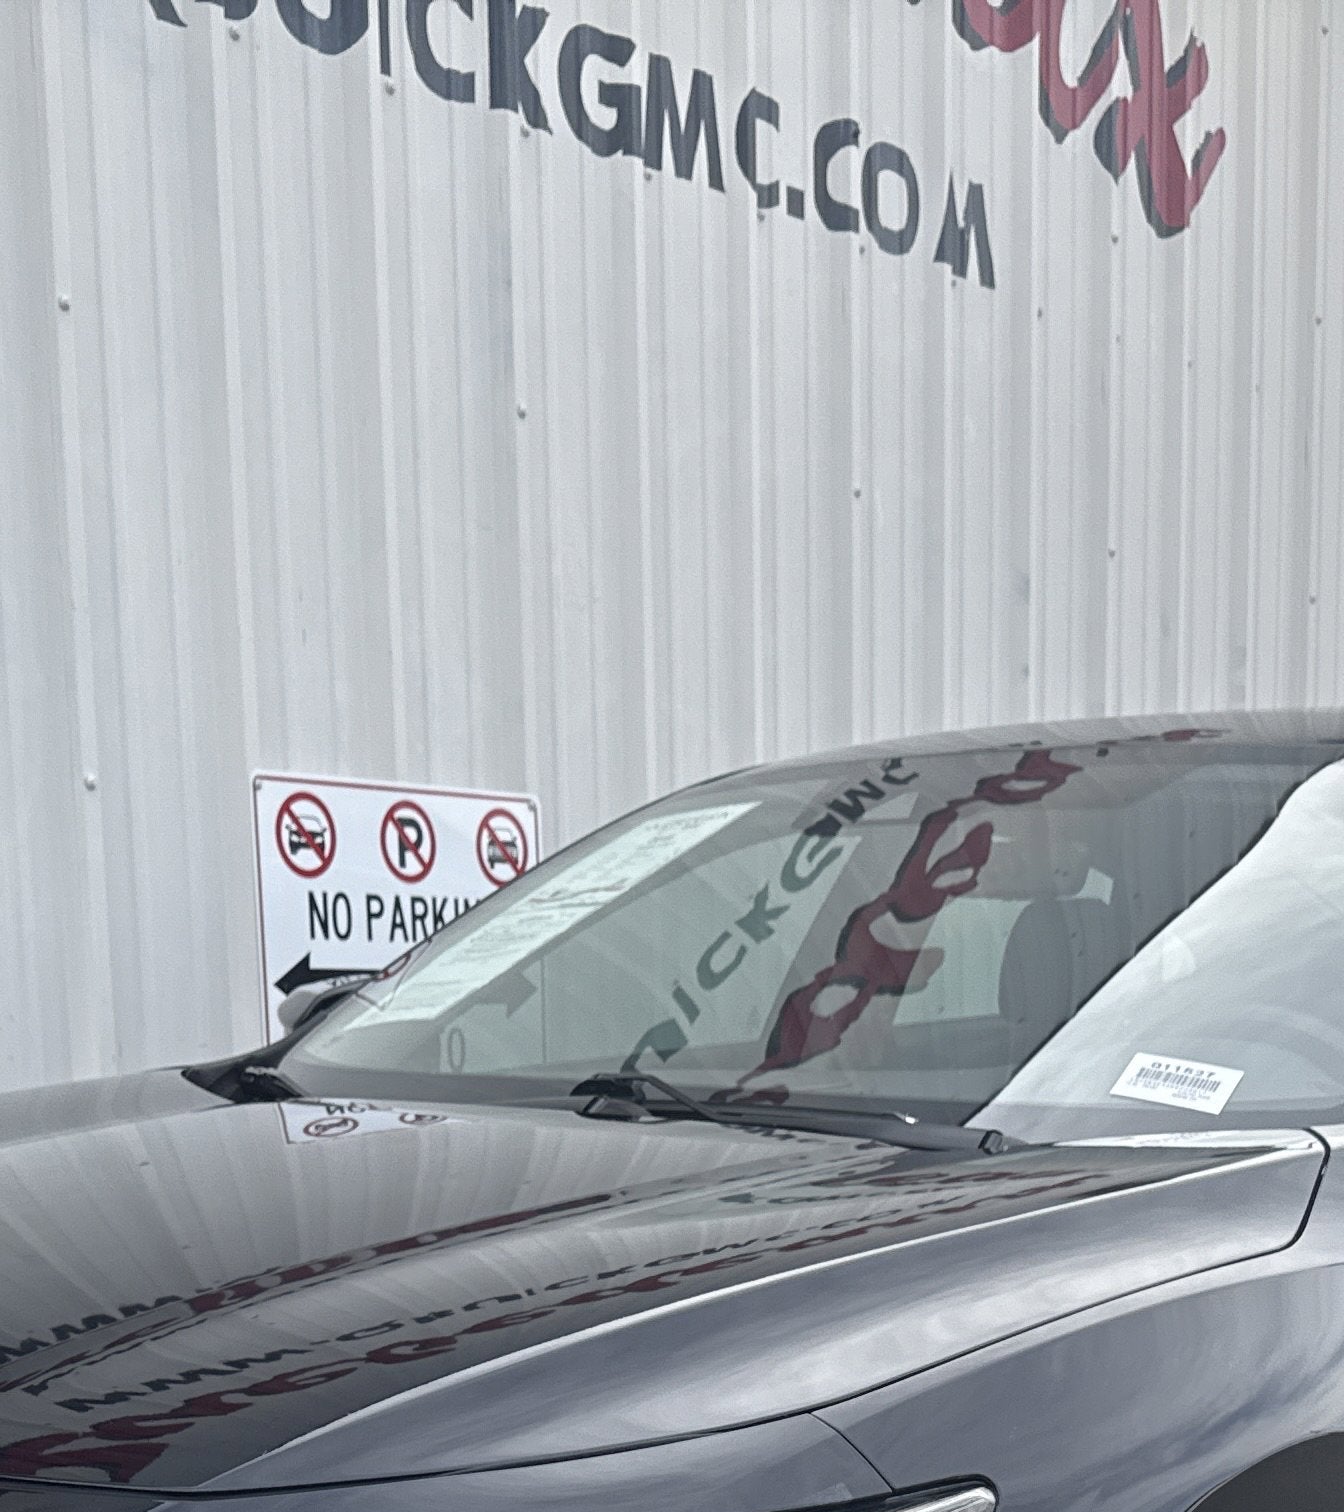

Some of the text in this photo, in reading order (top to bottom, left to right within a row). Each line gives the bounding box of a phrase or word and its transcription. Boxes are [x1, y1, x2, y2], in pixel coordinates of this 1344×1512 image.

[149, 0, 996, 290] ICKGMC.COM
[308, 891, 480, 943] NO PARK
